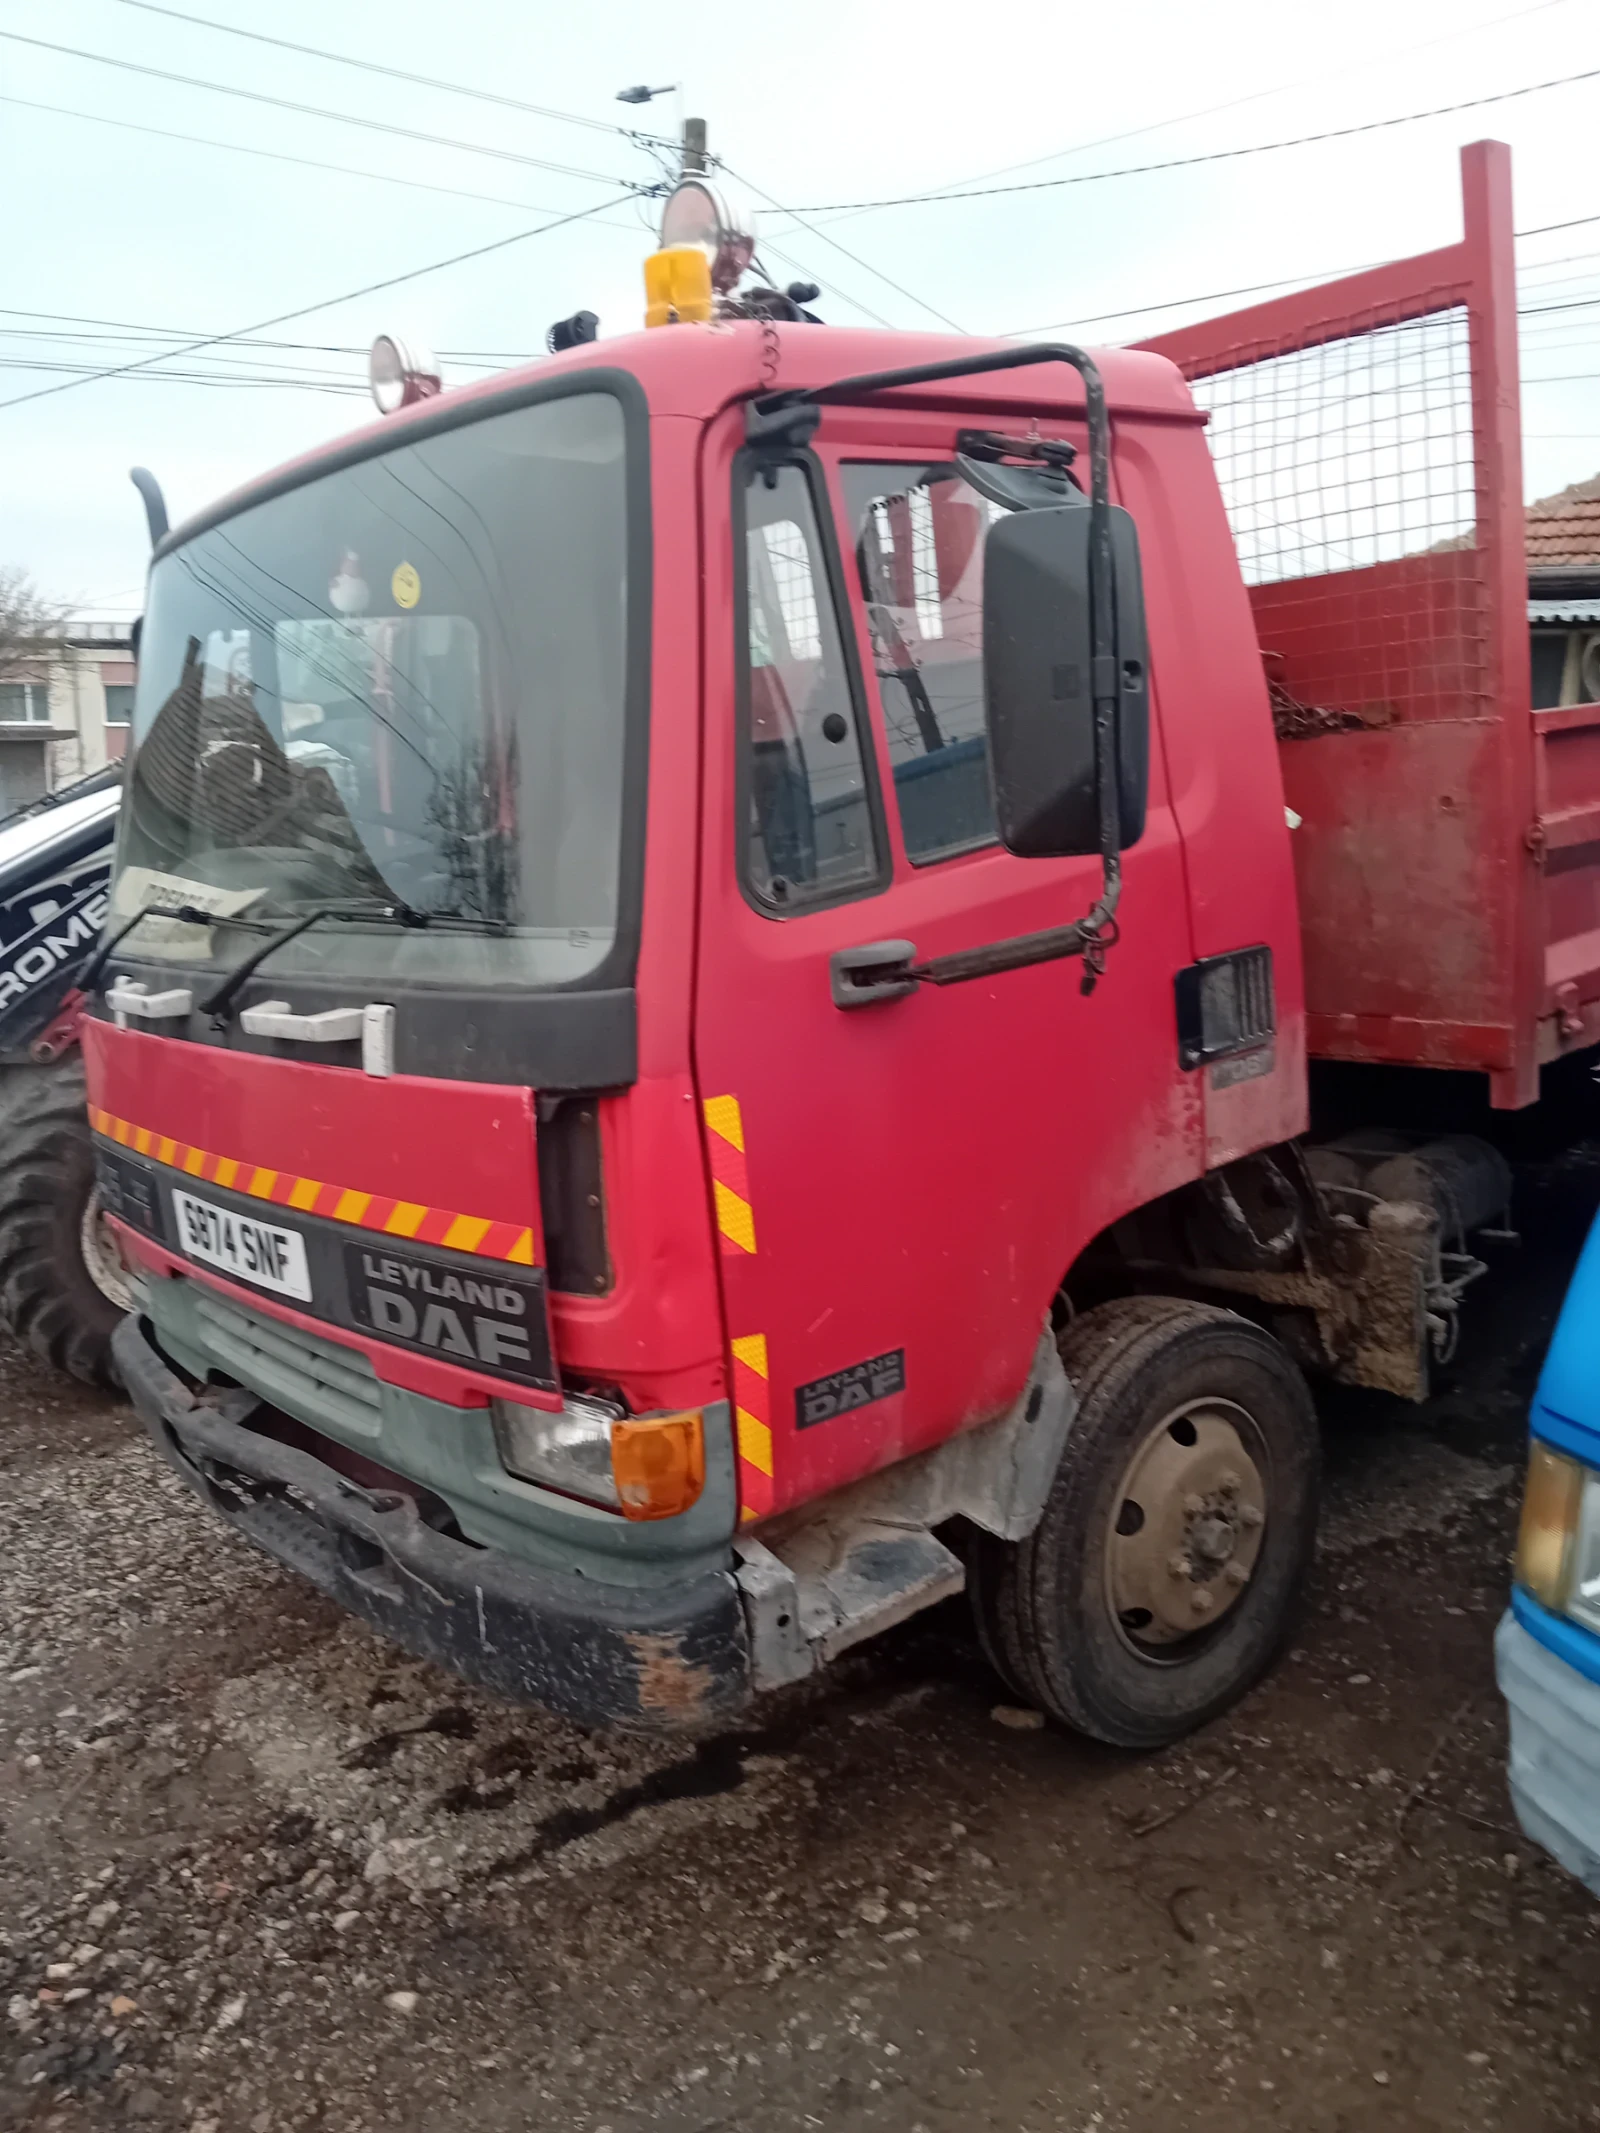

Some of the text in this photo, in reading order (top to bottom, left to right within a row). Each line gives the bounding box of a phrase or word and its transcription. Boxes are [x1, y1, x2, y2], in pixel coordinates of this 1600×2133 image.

[0, 889, 110, 1010] ROME
[240, 1223, 289, 1282] SNF
[362, 1253, 527, 1316] LEYLAND
[366, 1285, 532, 1366] DAF
[803, 1353, 899, 1399] LEYLAND
[804, 1368, 901, 1423] DAF
